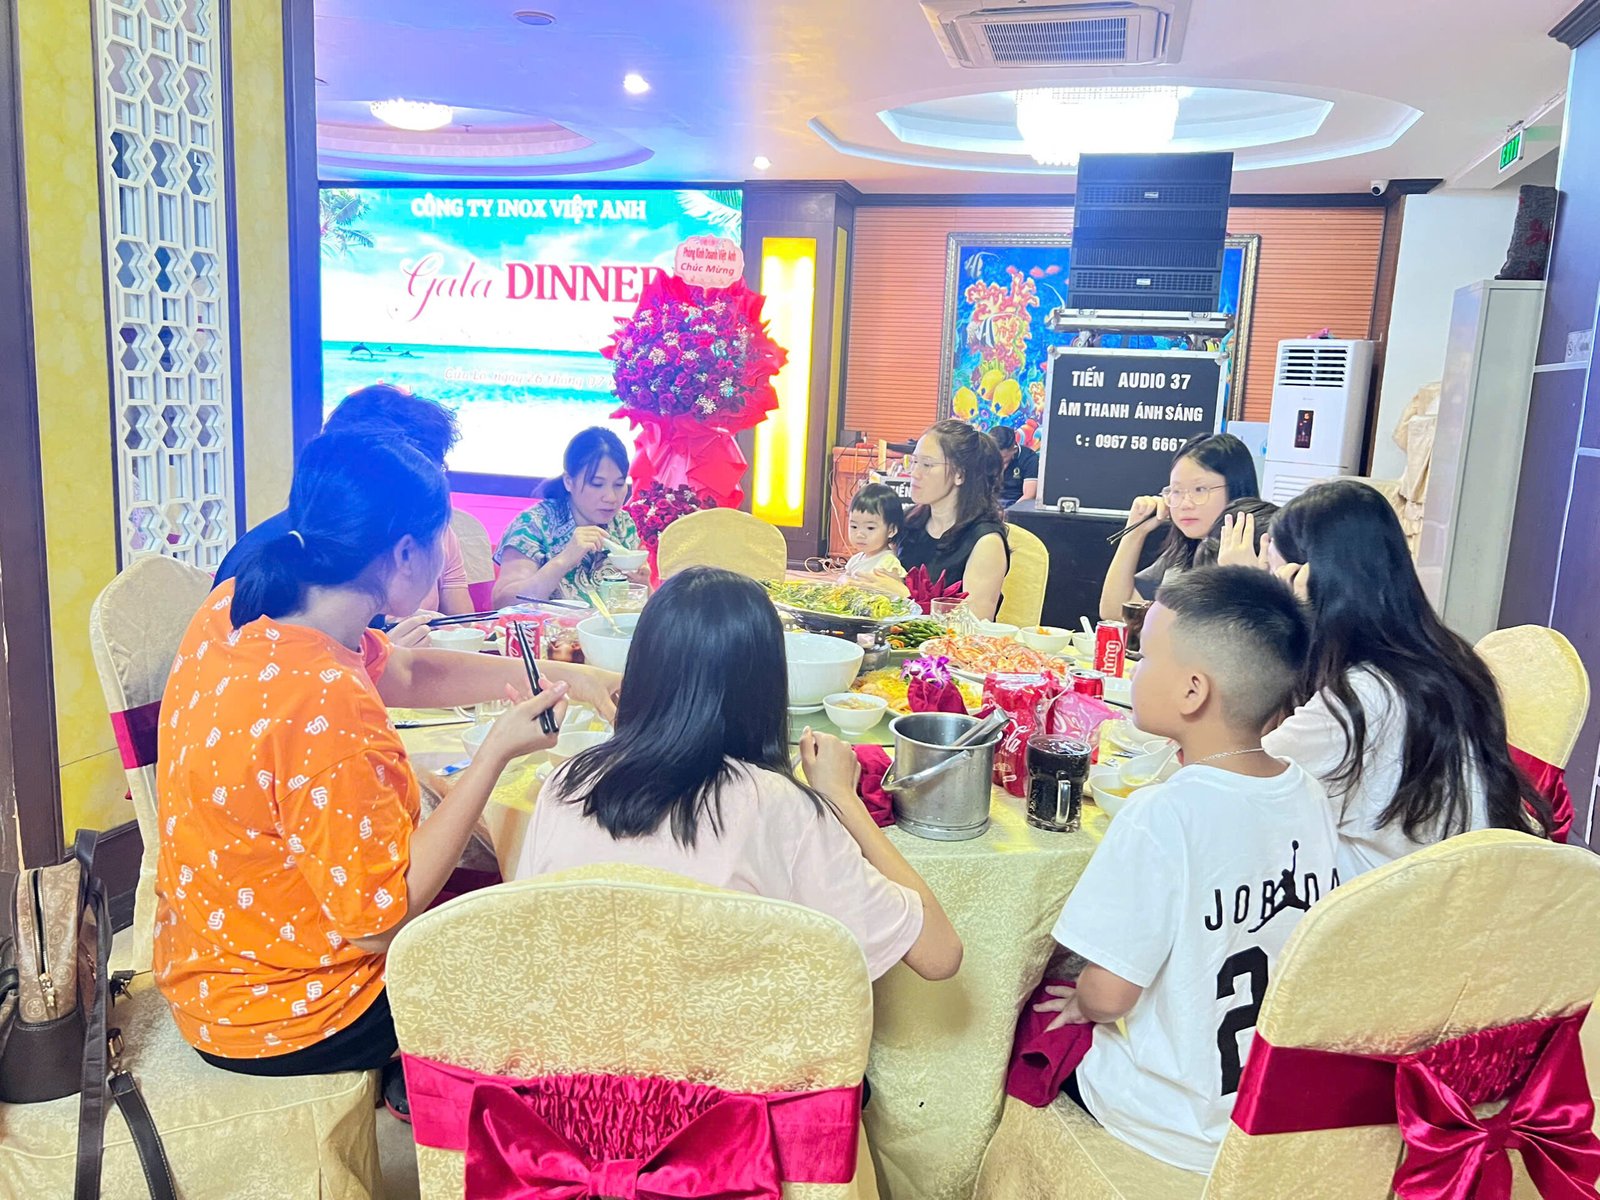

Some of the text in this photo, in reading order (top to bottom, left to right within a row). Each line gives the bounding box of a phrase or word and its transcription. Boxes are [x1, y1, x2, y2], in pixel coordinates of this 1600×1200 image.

[411, 193, 647, 224] CÔNG TY INOX VIỆT ANH
[680, 262, 703, 272] Chúc
[403, 255, 493, 322] Gala
[1072, 366, 1191, 390] TIẾN AUDIO 37
[1058, 398, 1203, 422] ÂM THANH ÁNH SÁNG
[1095, 433, 1127, 449] 0967
[1130, 435, 1148, 451] 58
[1216, 945, 1269, 1096] 2
